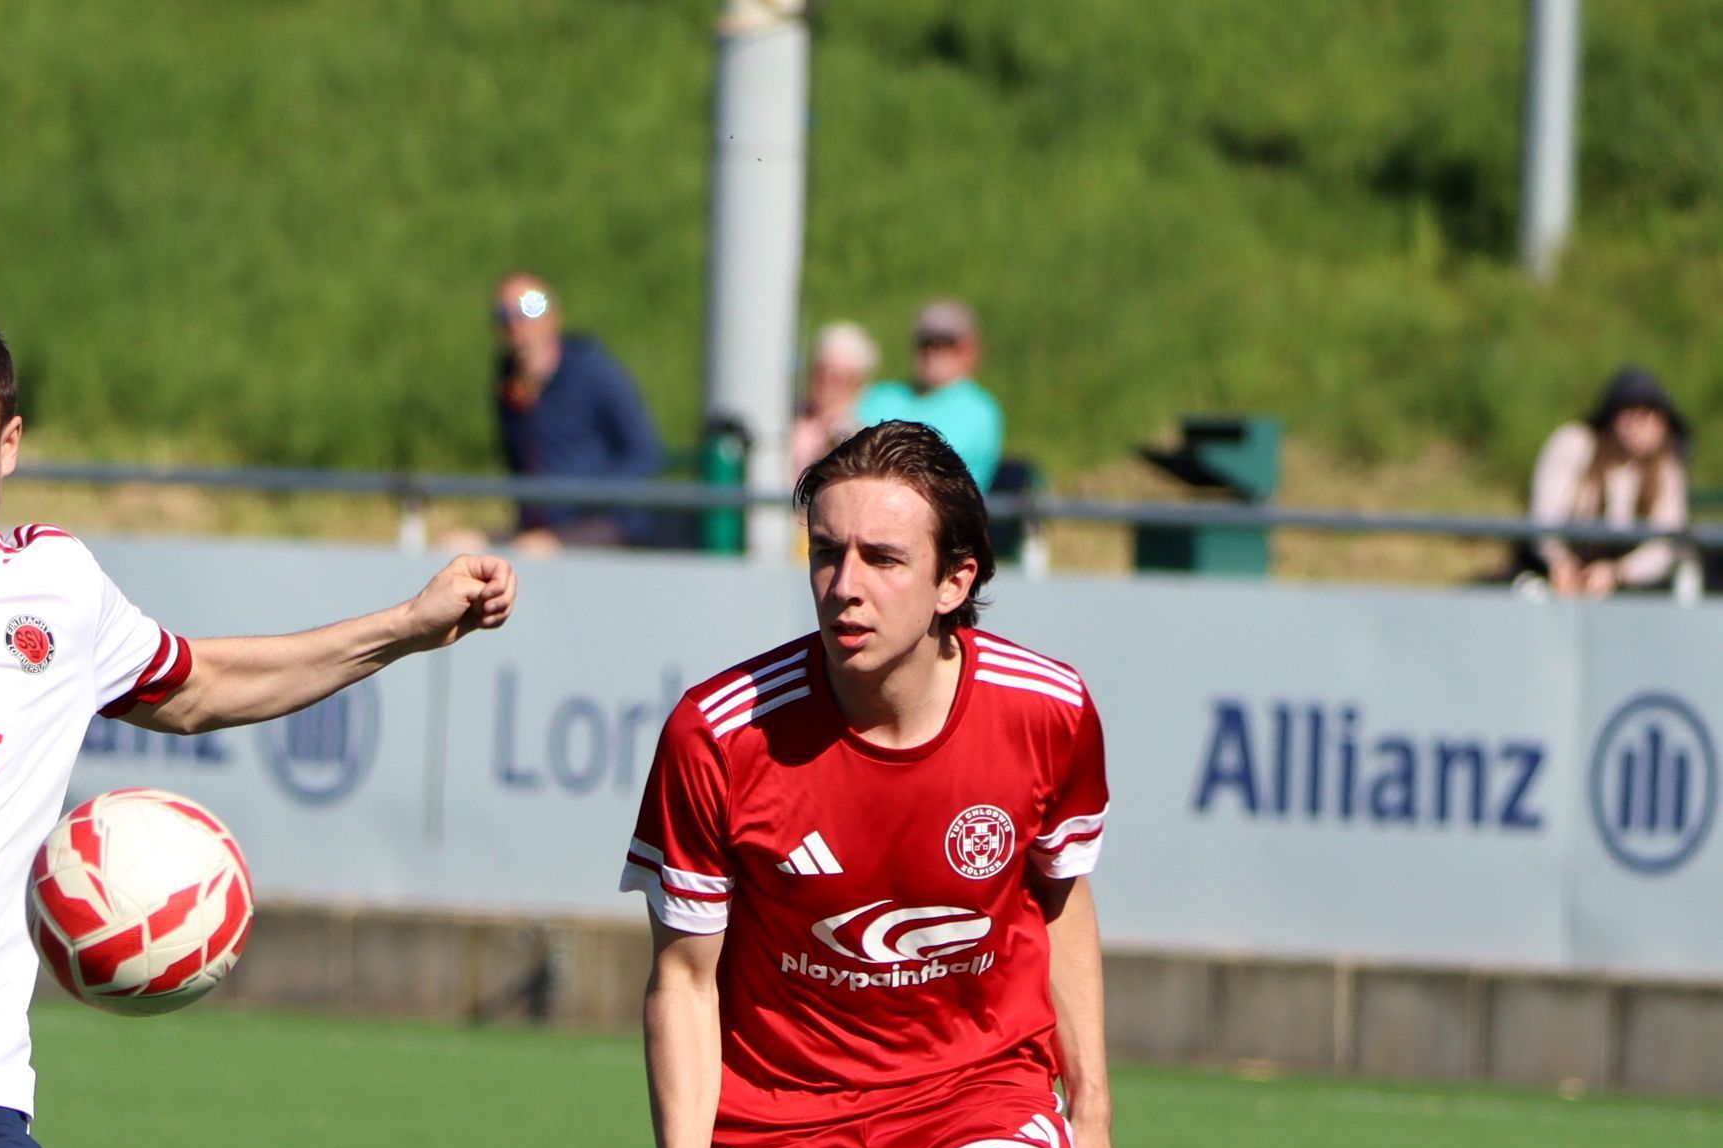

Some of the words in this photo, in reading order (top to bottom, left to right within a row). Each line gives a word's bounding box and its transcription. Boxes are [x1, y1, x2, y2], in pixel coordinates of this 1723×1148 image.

[15, 630, 44, 650] SSV
[1192, 698, 1546, 830] Allianz
[965, 808, 1011, 833] CHLODWIG
